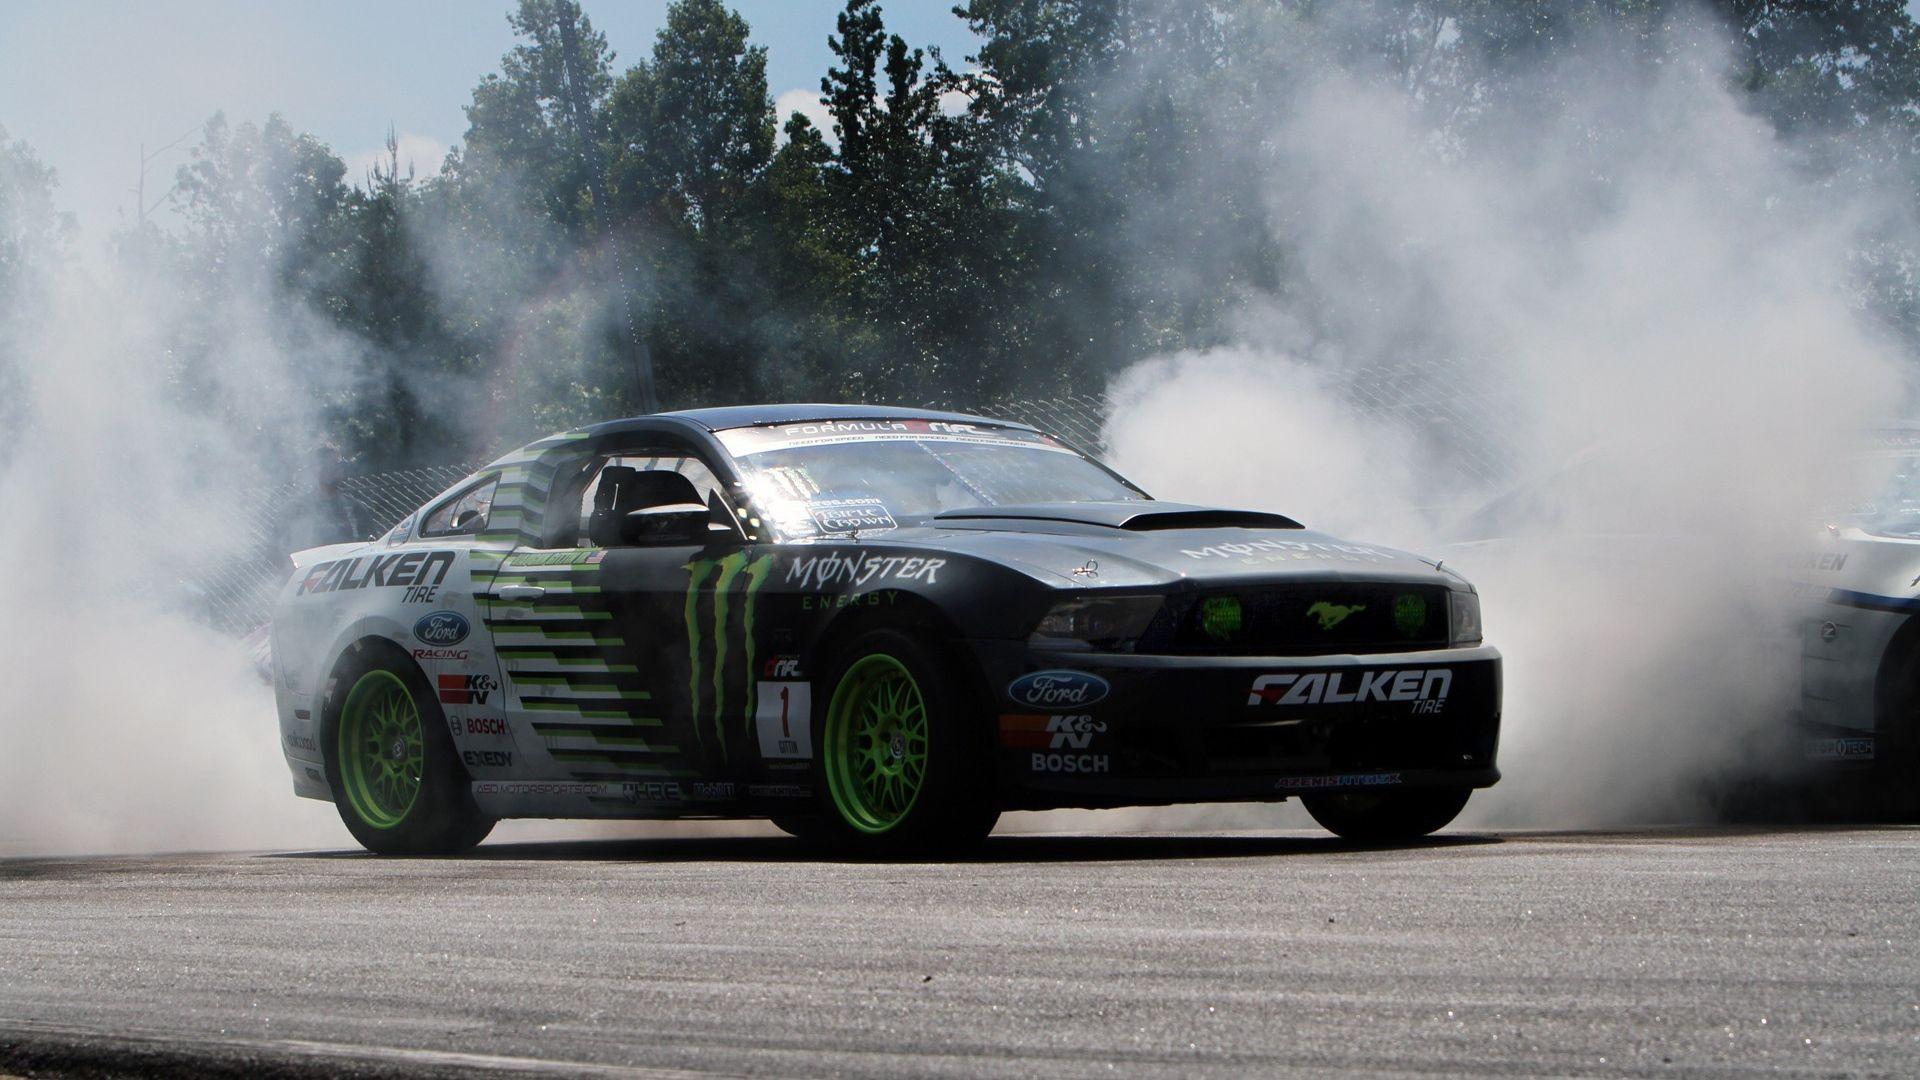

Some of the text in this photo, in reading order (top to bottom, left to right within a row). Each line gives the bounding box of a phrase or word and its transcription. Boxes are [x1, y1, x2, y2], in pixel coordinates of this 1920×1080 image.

[786, 422, 907, 436] FORMULA
[296, 551, 456, 596] FALKEN
[402, 586, 439, 603] TIRE
[802, 590, 898, 611] ENERGY
[425, 616, 459, 640] Ford
[411, 648, 469, 660] RACING
[1026, 675, 1089, 703] Ford
[1247, 668, 1453, 706] FALKEN
[780, 686, 790, 738] 1
[1410, 698, 1446, 714] TIRE
[467, 718, 505, 734] BOSCH
[463, 750, 513, 767] EXEDY
[1031, 753, 1110, 773] BOSCH
